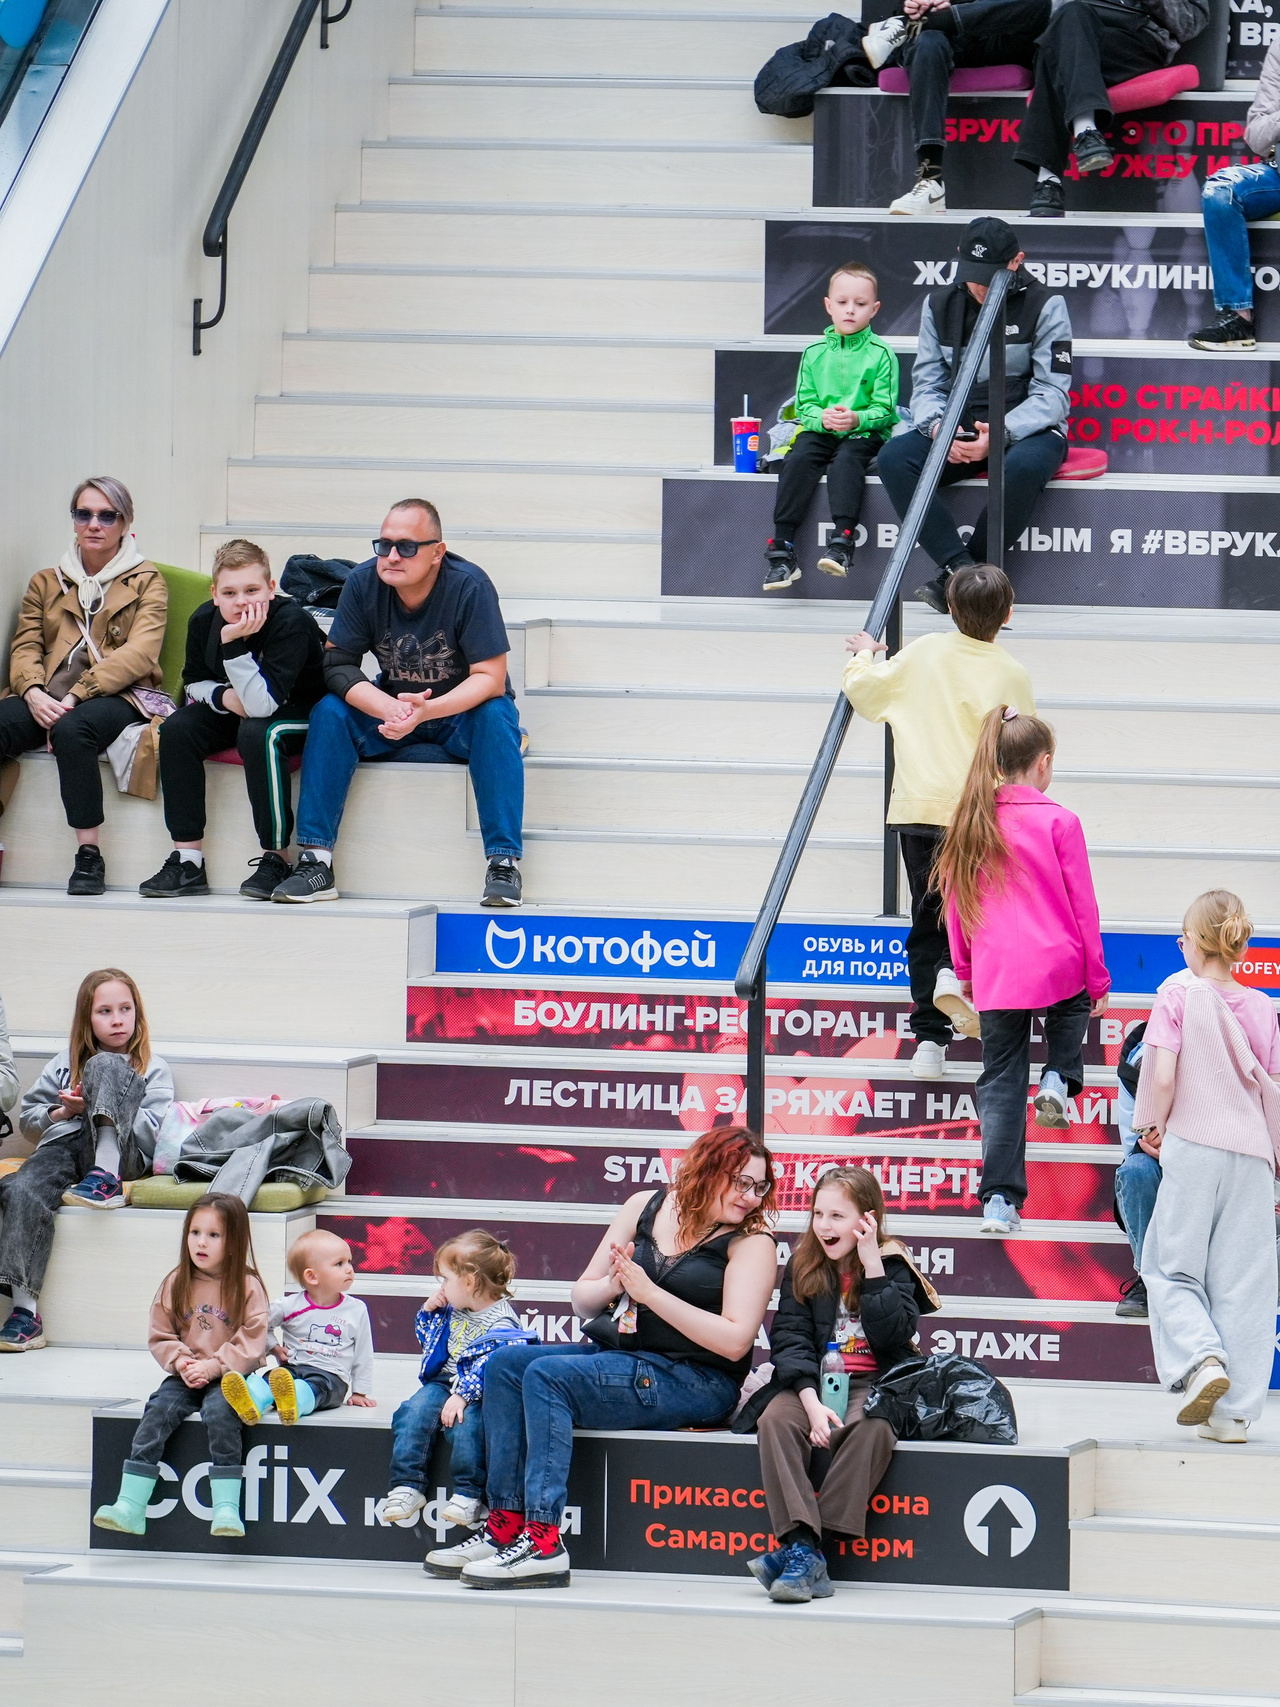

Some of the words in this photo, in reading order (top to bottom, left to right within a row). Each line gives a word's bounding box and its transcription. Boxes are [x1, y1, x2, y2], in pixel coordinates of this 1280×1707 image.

[1122, 121, 1188, 146] ЭТО
[1110, 529, 1133, 553] Я
[803, 936, 865, 953] ОБУВЬ
[871, 938, 884, 954] И
[802, 959, 845, 977] ДЛЯ
[504, 1079, 706, 1115] ЛЕСТНИЦА
[926, 1093, 979, 1120] НА
[931, 1329, 1060, 1362] ЭТАЖЕ
[630, 1479, 766, 1508] Прикасс
[866, 1494, 930, 1516] она
